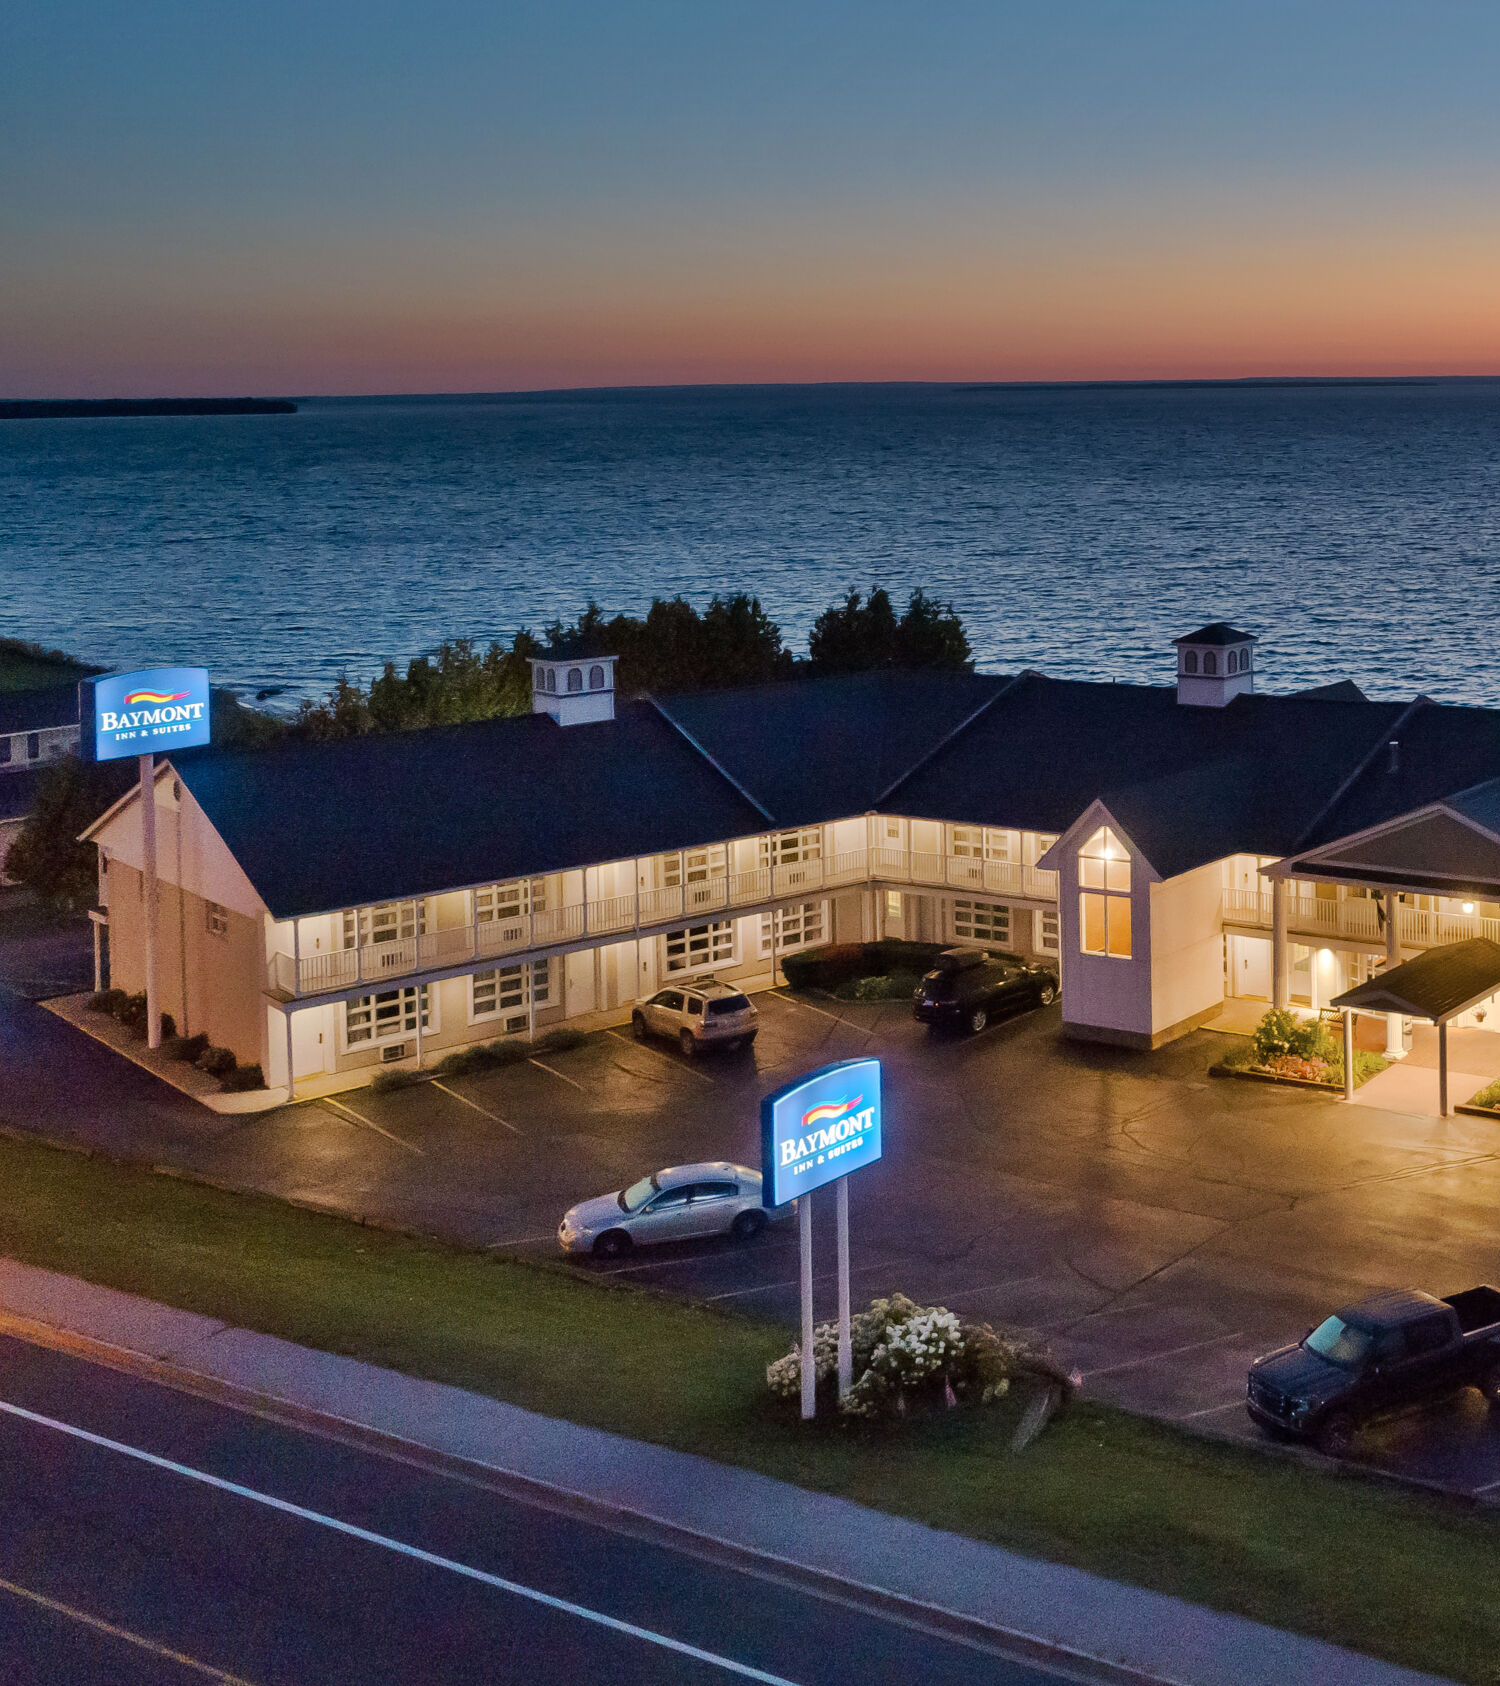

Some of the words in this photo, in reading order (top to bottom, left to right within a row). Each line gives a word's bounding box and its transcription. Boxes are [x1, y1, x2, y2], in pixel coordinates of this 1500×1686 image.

[101, 702, 204, 732] BAYMONT
[115, 731, 136, 741] INN
[153, 723, 192, 735] SUITES
[780, 1106, 875, 1166] BAYMONT
[793, 1159, 813, 1176] INN
[817, 1155, 825, 1165] &
[828, 1136, 863, 1160] SUITES
